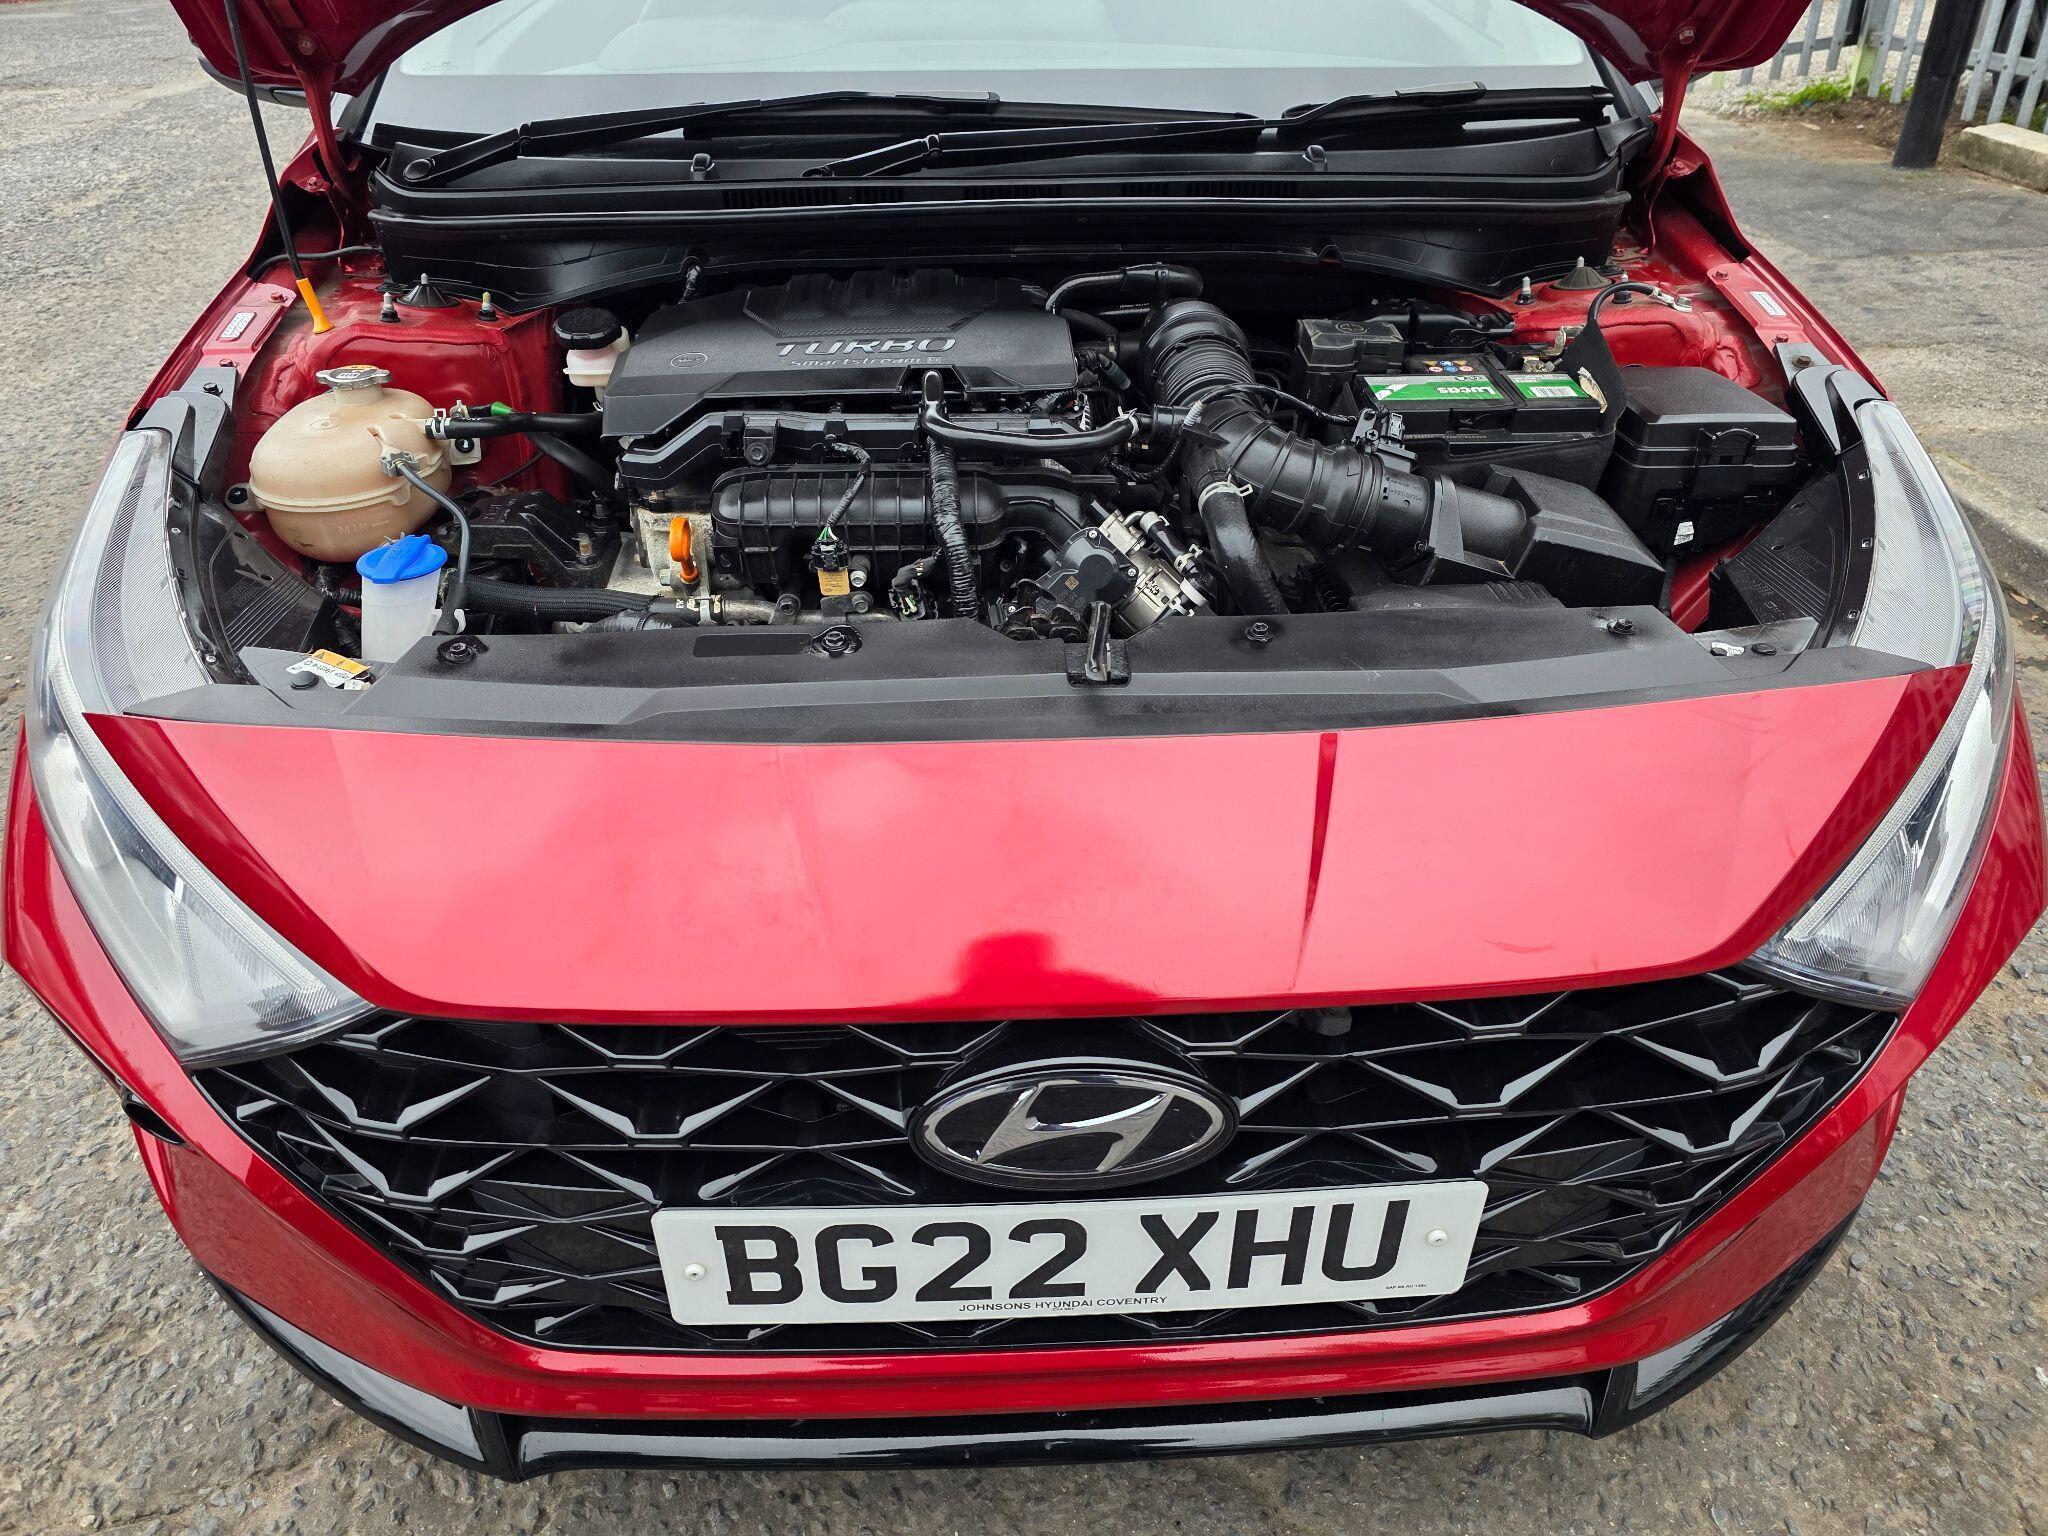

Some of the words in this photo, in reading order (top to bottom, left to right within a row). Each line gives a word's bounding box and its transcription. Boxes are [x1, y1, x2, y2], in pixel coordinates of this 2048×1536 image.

[776, 337, 956, 357] TURBO
[1437, 387, 1496, 395] Lucas
[714, 1219, 1087, 1305] BG22
[1135, 1200, 1410, 1293] XHU
[958, 1302, 1031, 1311] JOHNSONS
[1035, 1300, 1093, 1309] HYUNDAI
[1097, 1297, 1168, 1306] COVENTRY
